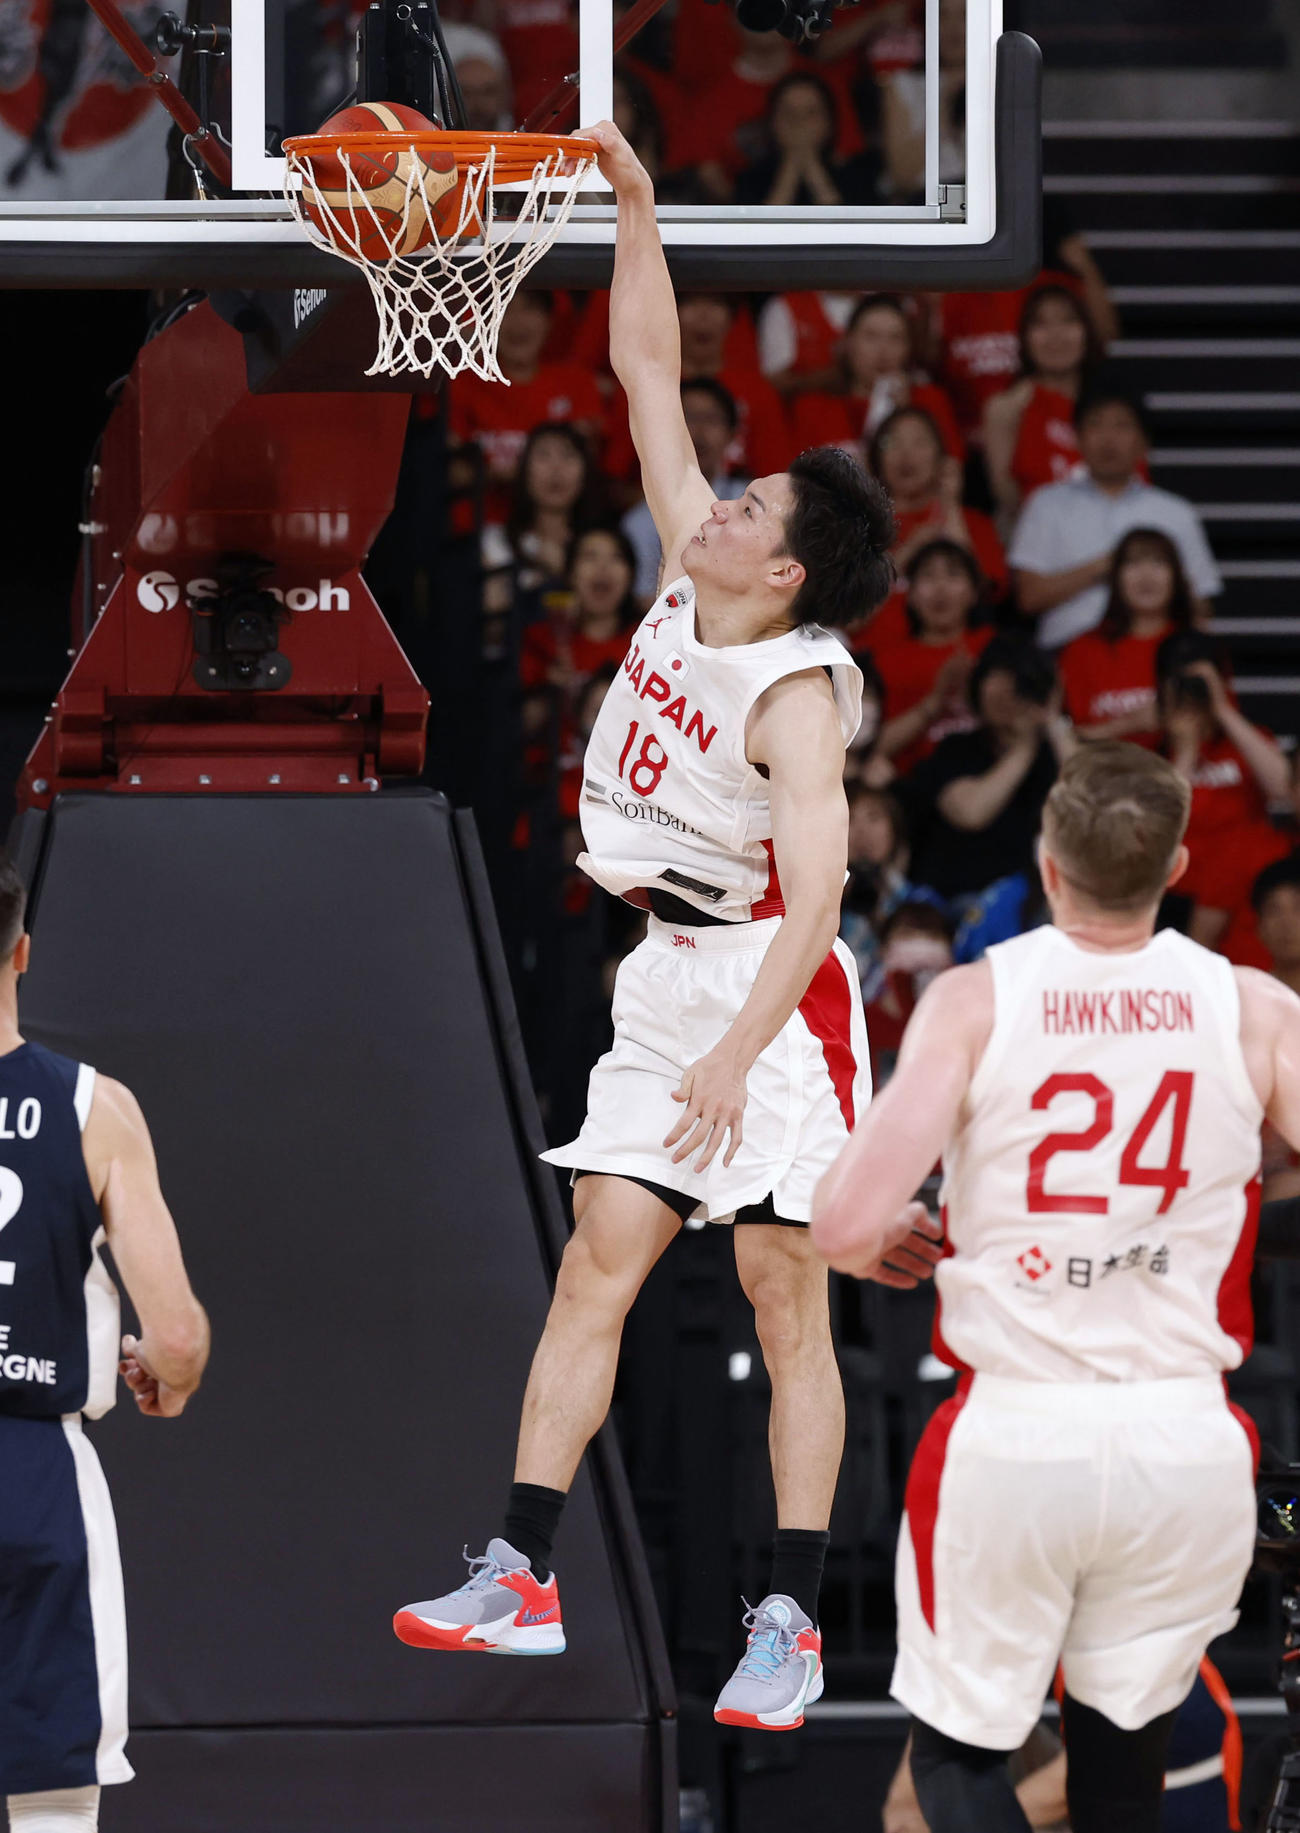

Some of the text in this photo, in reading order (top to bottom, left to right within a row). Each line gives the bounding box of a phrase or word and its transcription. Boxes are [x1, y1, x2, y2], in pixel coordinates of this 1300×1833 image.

[185, 578, 350, 612] Soh
[624, 643, 718, 754] JAPAN
[618, 720, 668, 797] 18
[671, 934, 696, 950] JPN
[1043, 990, 1195, 1035] HAWKINSON
[1026, 1070, 1195, 1214] 24
[0, 1353, 57, 1385] GNE
